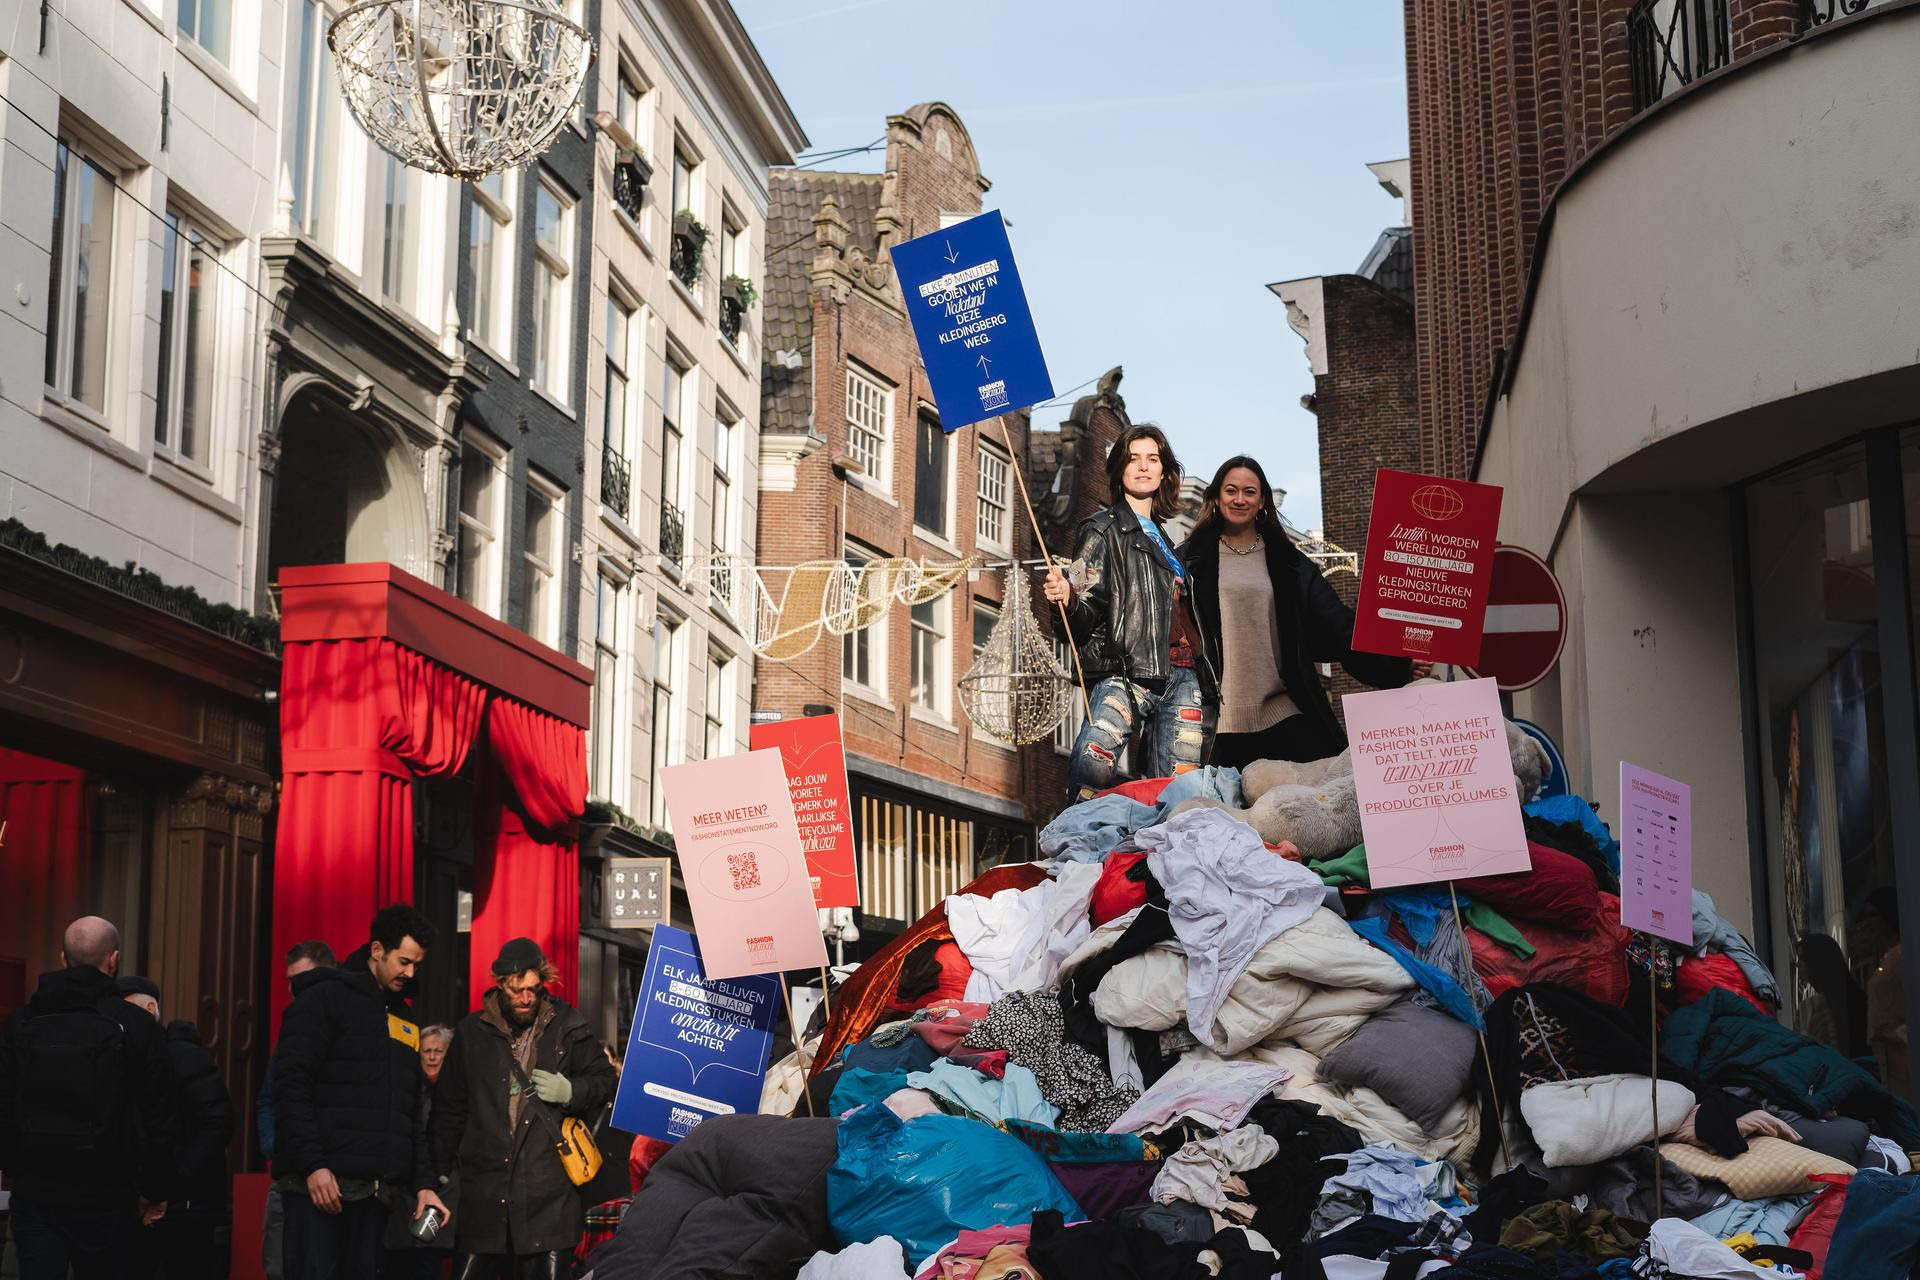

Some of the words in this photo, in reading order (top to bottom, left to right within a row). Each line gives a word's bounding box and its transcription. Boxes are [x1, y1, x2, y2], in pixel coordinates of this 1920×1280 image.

[920, 282, 943, 296] ELKE
[944, 277, 953, 287] 10
[954, 262, 998, 285] MINUTEN
[928, 286, 968, 307] GOOIEN
[968, 280, 986, 293] WE
[986, 275, 998, 287] IN
[944, 290, 986, 318] Nederland
[956, 308, 981, 325] DEZE
[939, 313, 1007, 344] KLEDINGBERG
[963, 333, 991, 349] WEG.
[978, 380, 1005, 392] FASHION
[982, 391, 1008, 409] NOW
[1395, 540, 1466, 560] WERELDWIJD
[1431, 533, 1480, 549] WORDEN
[1385, 551, 1424, 565] 80-150
[1426, 558, 1473, 573] MILJARD
[1406, 567, 1448, 582] NIEUWE
[1378, 575, 1472, 598] KLEDINGSTUKKEN
[1378, 587, 1468, 610] GEPRODUCEERD.
[1405, 626, 1433, 637] FASHION
[1361, 725, 1418, 741] MERKEN,
[1422, 720, 1461, 734] MAAK
[1465, 717, 1490, 729] HET
[1358, 739, 1417, 754] FASHION
[1420, 728, 1497, 747] STATEMENT
[1375, 753, 1400, 765] DAT
[1404, 749, 1437, 762] TELT.
[1440, 744, 1478, 758] WEES
[1383, 756, 1479, 782] transparant
[804, 774, 827, 786] JOUW
[1407, 782, 1444, 795] OVER
[1448, 780, 1464, 791] JE
[790, 786, 823, 800] VORIETE
[1365, 787, 1511, 813] PRODUCTIEVOLUMES.
[693, 811, 723, 826] MEER
[724, 804, 768, 821] WETEN?
[793, 799, 822, 812] GMERK
[823, 798, 838, 809] OM
[797, 811, 837, 824] AARLIJKSE
[691, 821, 778, 841] FASHIONSTATEMENTNOW.ORG
[1429, 844, 1465, 854] FASHION
[746, 935, 774, 945] FASHION
[663, 964, 685, 980] ELK
[686, 972, 716, 989] JAAR
[719, 981, 765, 1004] BLIJVEN
[671, 981, 700, 998] 8-60
[704, 991, 752, 1014] MILJARD
[655, 990, 755, 1030] KLEDINGSTUKKEN
[671, 1012, 740, 1041] onverkocht
[677, 1029, 726, 1052] ACHTER.
[672, 1107, 703, 1121] FASHION
